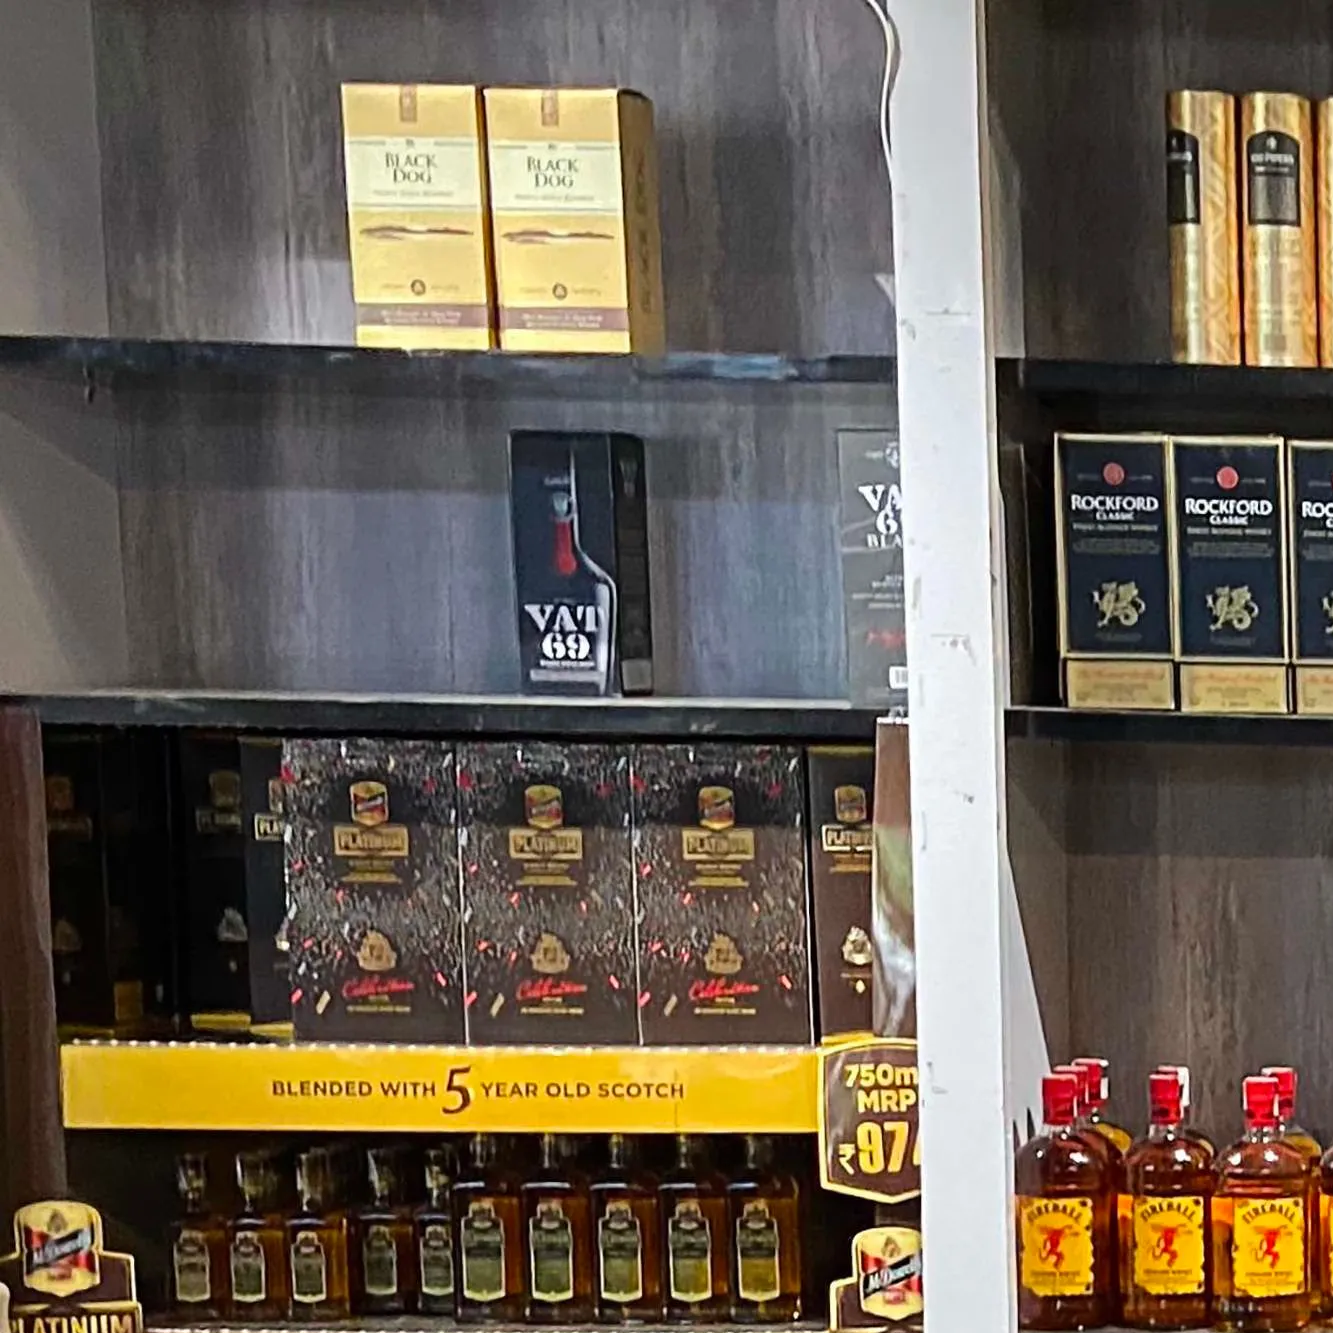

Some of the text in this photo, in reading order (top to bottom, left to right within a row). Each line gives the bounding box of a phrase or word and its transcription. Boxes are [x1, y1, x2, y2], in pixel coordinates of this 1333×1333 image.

[385, 151, 437, 169] BLACK
[526, 156, 579, 173] BLACK
[392, 168, 432, 184] DOG
[534, 172, 574, 188] DOG
[858, 485, 903, 512] VA
[1071, 494, 1159, 513] ROCKFORD
[1185, 498, 1273, 517] ROCKFORD
[875, 511, 901, 535] 6
[1096, 511, 1135, 521] CLASSIC
[1209, 515, 1249, 526] CLASSIC
[524, 603, 603, 632] VAT
[541, 632, 590, 660] 69
[845, 1063, 918, 1087] 750m
[272, 1066, 685, 1114] BLENDED WITH 5 YEAR OLD SCOTCH
[857, 1089, 917, 1113] MRP
[1025, 1200, 1083, 1221] FIREBALL
[1140, 1199, 1196, 1223] FIREBALL
[1241, 1199, 1297, 1225] FIREBALL
